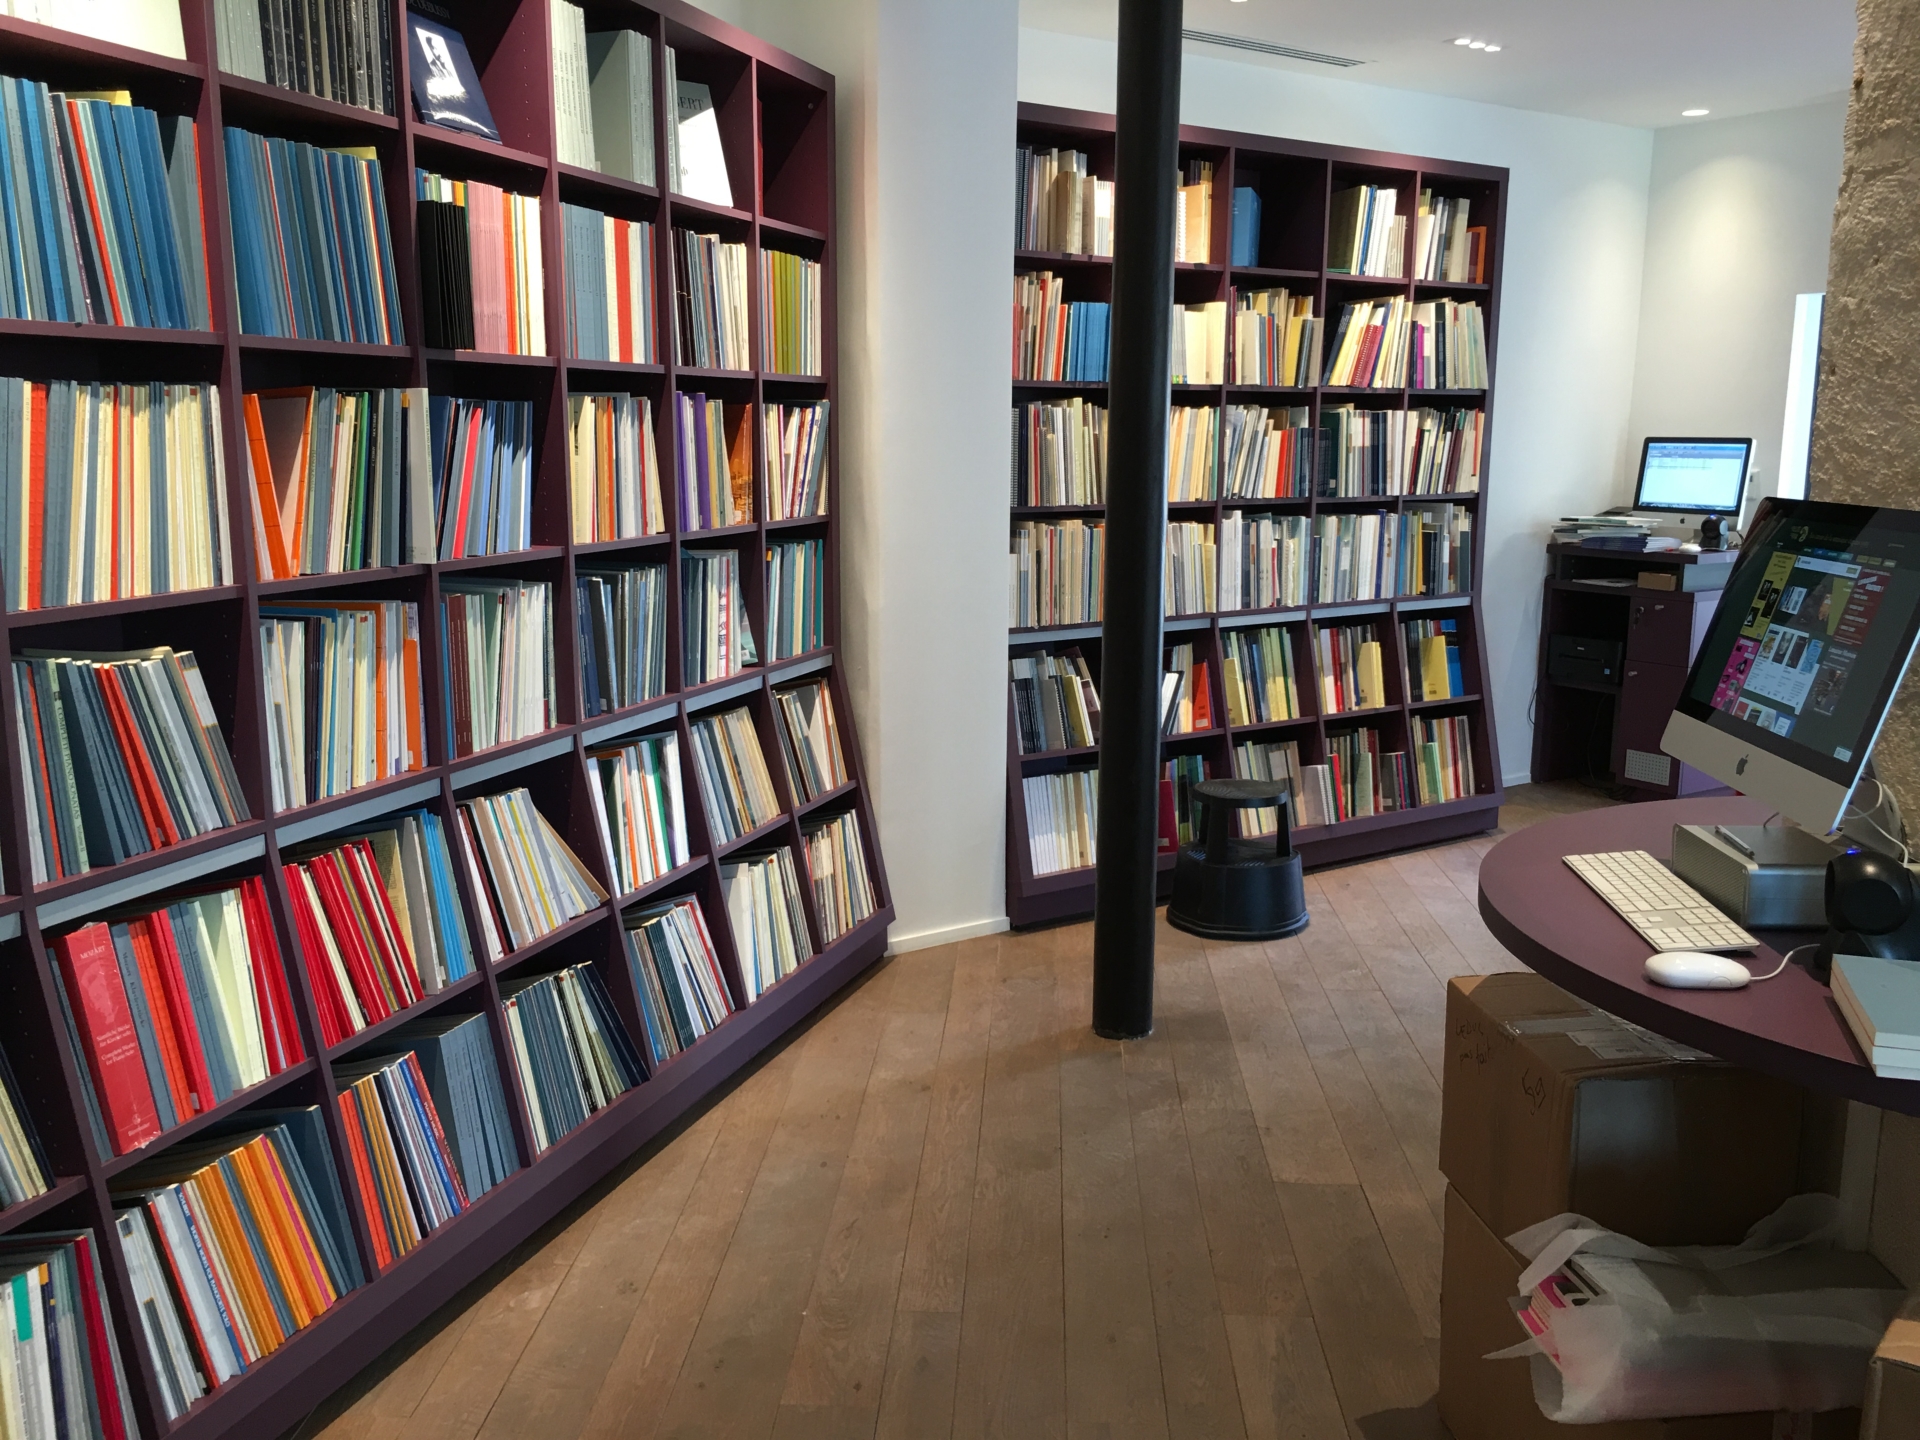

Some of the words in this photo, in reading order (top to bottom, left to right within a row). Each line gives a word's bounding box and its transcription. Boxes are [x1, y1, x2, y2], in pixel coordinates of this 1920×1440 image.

[57, 707, 70, 751] COMPLETE
[64, 753, 74, 780] PIANO
[69, 782, 80, 819] SONATAS
[80, 945, 105, 960] MOZART
[122, 952, 131, 977] Mozart
[424, 1102, 433, 1119] PIANO
[178, 1192, 191, 1217] SCHUBERT
[190, 1225, 202, 1249] SHORTER
[210, 1279, 225, 1311] PIANOFORTE
